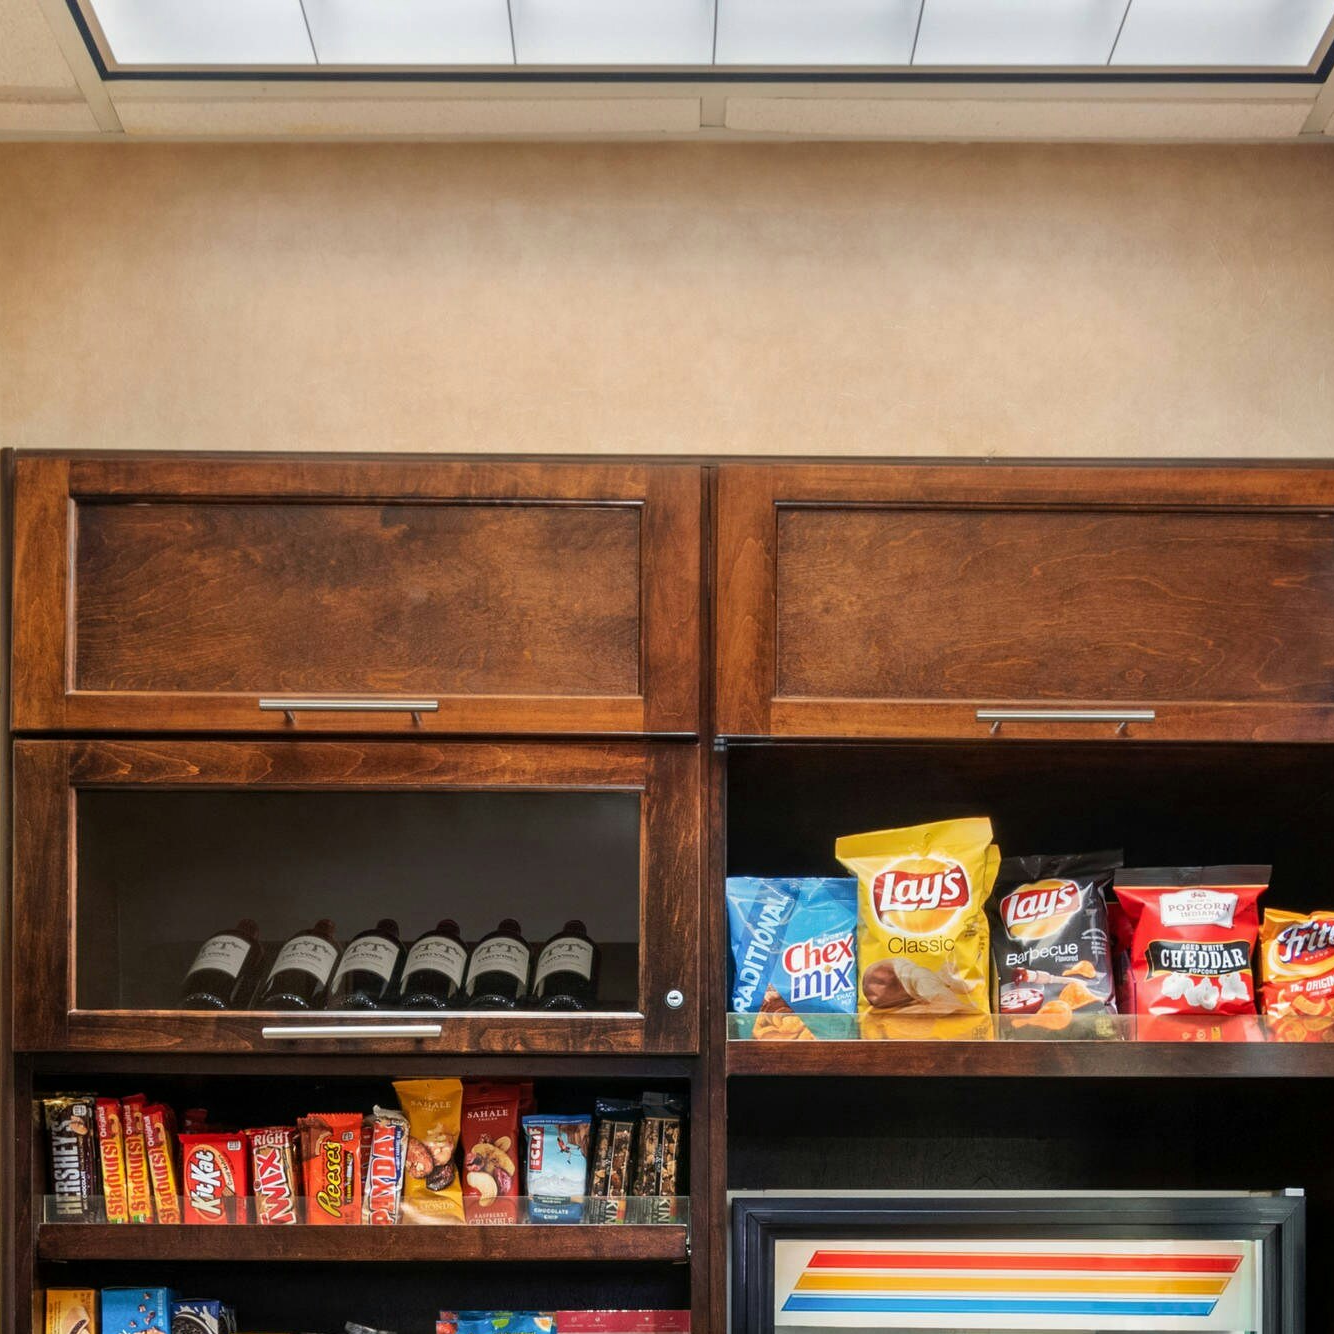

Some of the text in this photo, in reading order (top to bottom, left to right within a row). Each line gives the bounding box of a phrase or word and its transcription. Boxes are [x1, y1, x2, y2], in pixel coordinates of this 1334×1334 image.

[880, 870, 962, 912] Lay's
[1006, 884, 1074, 928] Lay's
[1168, 903, 1231, 913] POPCORN
[1180, 910, 1221, 919] INDIANA
[785, 934, 854, 972] Chex
[888, 936, 955, 954] Classic
[1006, 942, 1079, 967] Barbecue
[1180, 943, 1224, 951] AGED WHITE
[1055, 954, 1079, 963] Flavored
[1160, 948, 1247, 970] CHEDDAR
[792, 960, 854, 1000] mix
[466, 1108, 509, 1119] SAHALE
[254, 1131, 289, 1146] RIGHT
[529, 1128, 543, 1161] CLIF
[52, 1118, 83, 1216] HERSHEY'S
[99, 1137, 124, 1217] Starburst
[125, 1136, 149, 1213] Starburst
[369, 1121, 397, 1224] PAYDAY
[534, 1207, 569, 1216] CHOCOLATE
